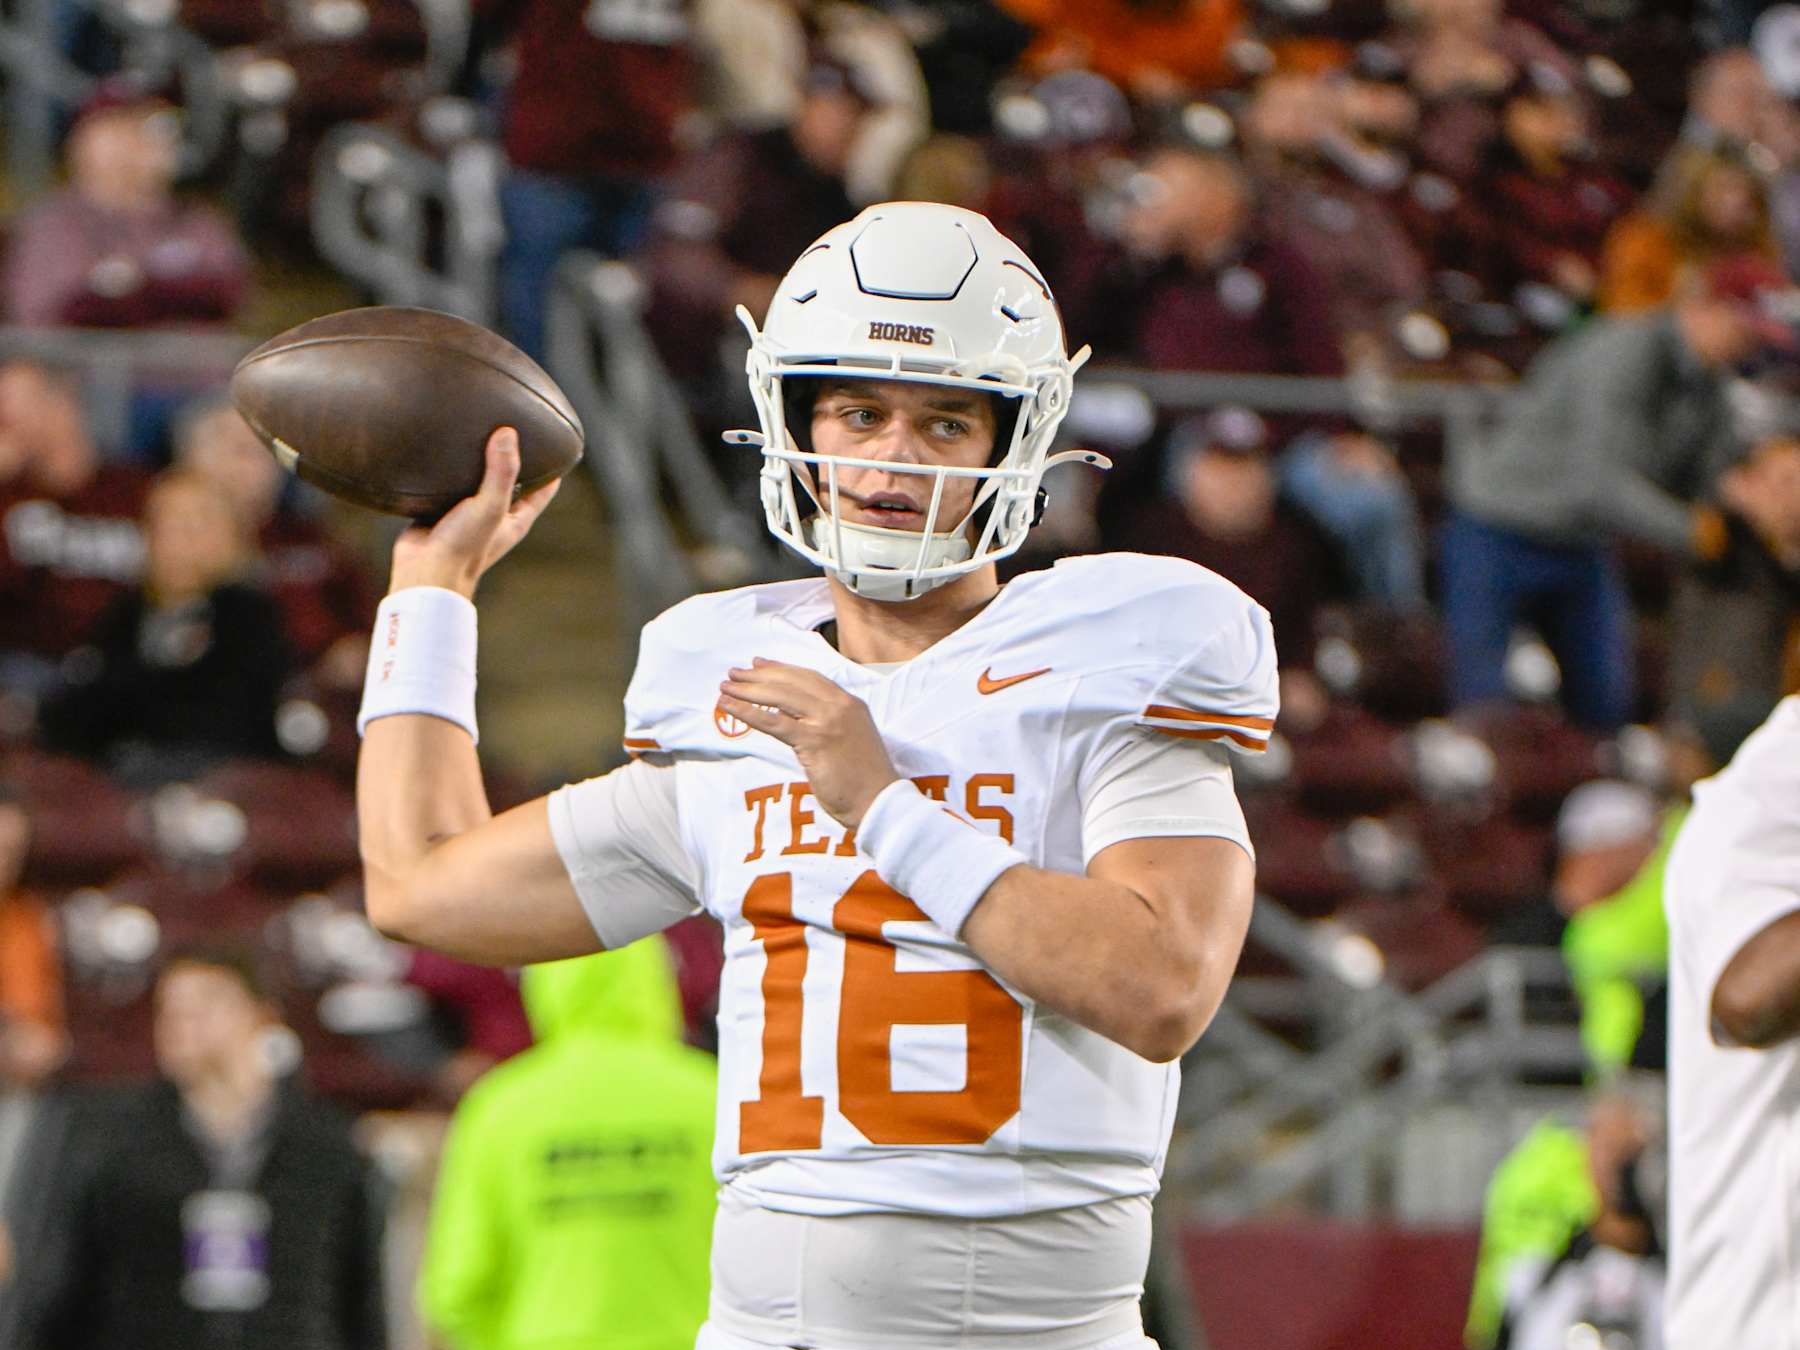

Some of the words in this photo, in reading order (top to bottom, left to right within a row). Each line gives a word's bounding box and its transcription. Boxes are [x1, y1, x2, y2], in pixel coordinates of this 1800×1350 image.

[868, 321, 935, 346] HORNS
[744, 773, 1015, 863] TES
[740, 869, 1024, 1155] 16
